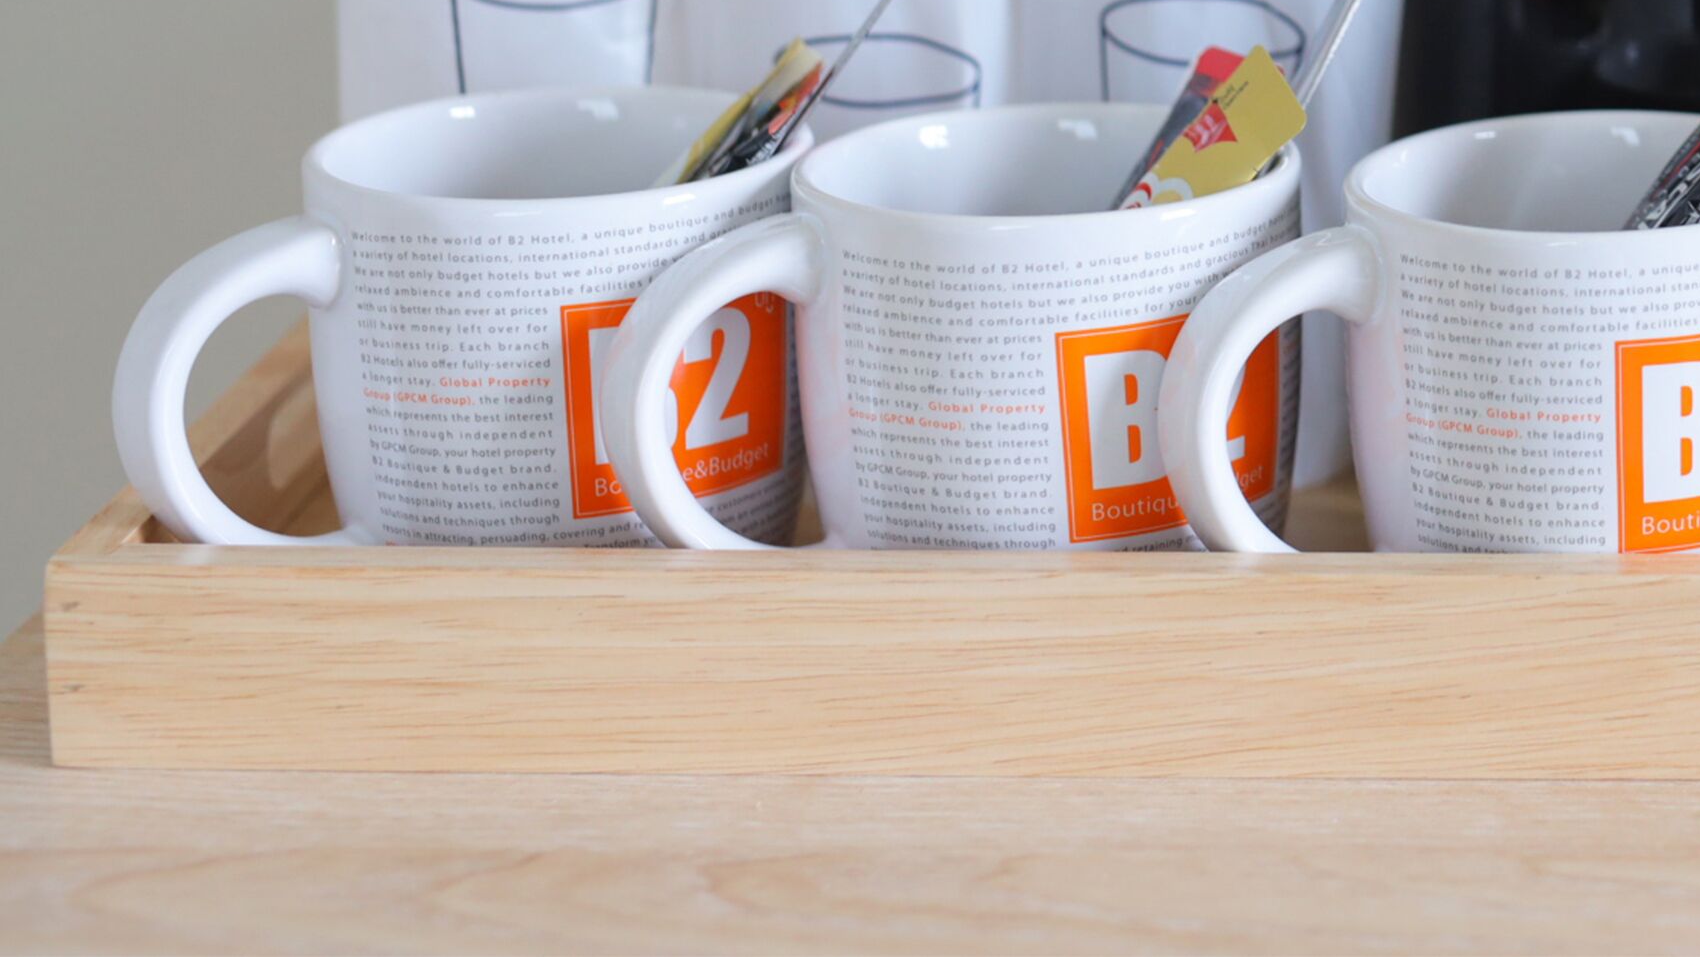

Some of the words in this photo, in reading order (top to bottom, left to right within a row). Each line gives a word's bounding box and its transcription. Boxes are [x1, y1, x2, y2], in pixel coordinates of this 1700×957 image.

[1400, 253, 1448, 271] Welcome
[1452, 262, 1466, 273] to
[1470, 263, 1492, 276] the
[1497, 267, 1538, 279] world
[1543, 268, 1558, 279] of
[1564, 268, 1581, 280] B2
[1638, 268, 1645, 277] a
[1651, 263, 1699, 276] unique
[1400, 272, 1405, 281] a
[1408, 275, 1444, 290] variety
[1448, 279, 1460, 289] of
[1463, 280, 1496, 294] hotel
[1574, 283, 1666, 297] international
[1401, 289, 1414, 301] We
[1418, 294, 1433, 304] are
[1436, 297, 1455, 308] not
[1459, 299, 1485, 312] only
[1489, 301, 1536, 316] budget
[1542, 304, 1584, 316] hotels
[1589, 305, 1613, 315] but
[1618, 305, 1637, 314] we
[1642, 301, 1669, 313] also
[1401, 308, 1439, 323] relaxed
[1442, 315, 1503, 330] ambience
[1509, 322, 1534, 332] and
[1539, 321, 1629, 333] comfortable
[1635, 317, 1698, 330] facilities
[1402, 326, 1422, 337] with
[1424, 331, 1435, 340] us
[1437, 331, 1446, 342] is
[1448, 332, 1481, 345] better
[1485, 336, 1512, 348] than
[1516, 341, 1542, 350] ever
[1547, 341, 1559, 351] at
[1563, 341, 1602, 353] prices
[1402, 343, 1423, 355] still
[1427, 346, 1453, 360] have
[1458, 353, 1501, 367] money
[1507, 356, 1532, 368] left
[1539, 360, 1572, 369] over
[1579, 358, 1600, 369] for
[362, 371, 367, 380] a
[369, 370, 403, 386] longer
[439, 376, 483, 388] Global
[488, 377, 550, 388] Property
[1403, 362, 1414, 371] or
[1417, 363, 1468, 381] business
[1508, 374, 1542, 386] Each
[1549, 376, 1602, 387] branch
[363, 387, 391, 402] Group
[393, 391, 427, 403] (GPCM
[479, 395, 499, 405] the
[503, 393, 553, 406] leading
[847, 392, 852, 401] a
[855, 391, 889, 407] longer
[928, 400, 974, 413] Global
[980, 403, 1045, 415] Property
[1405, 377, 1416, 390] B2
[1418, 381, 1450, 396] Hotels
[1453, 387, 1476, 399] also
[1478, 390, 1506, 402] offer
[1510, 391, 1603, 406] fully-serviced
[848, 406, 877, 422] Group
[879, 412, 915, 425] (GPCM
[970, 421, 992, 431] the
[996, 421, 1049, 432] leading
[850, 426, 877, 439] which
[879, 432, 936, 446] represents
[940, 436, 960, 447] the
[965, 438, 992, 449] best
[997, 438, 1048, 448] interest
[372, 454, 383, 467] B2
[387, 457, 438, 474] Boutique
[443, 464, 450, 474] &
[455, 464, 503, 477] Budget
[853, 444, 886, 457] assets
[890, 449, 942, 465] through
[949, 455, 1048, 467] independent
[594, 443, 769, 497] Boe&Budget
[868, 462, 893, 475] GPCM
[932, 472, 958, 481] your
[961, 471, 993, 482] hotel
[997, 473, 1052, 484] property
[375, 474, 437, 490] independent
[441, 480, 479, 492] hotels
[484, 483, 498, 492] to
[502, 481, 559, 492] enhance
[857, 476, 869, 489] B2
[873, 479, 925, 496] Boutique
[931, 486, 939, 497] &
[945, 487, 996, 502] Budget
[376, 490, 396, 501] your
[398, 493, 453, 511] hospitality
[499, 497, 560, 509] including
[860, 496, 926, 512] independent
[930, 502, 971, 515] hotels
[976, 506, 990, 516] to
[995, 505, 1055, 516] enhance
[411, 528, 422, 539] in
[552, 527, 605, 541] covering
[609, 521, 630, 534] and
[422, 515, 440, 525] and
[443, 516, 506, 529] techniques
[509, 513, 560, 526] through
[885, 514, 943, 532] hospitality
[993, 521, 1056, 533] including
[911, 535, 931, 546] and
[933, 537, 1000, 551] techniques
[1004, 537, 1055, 550] through
